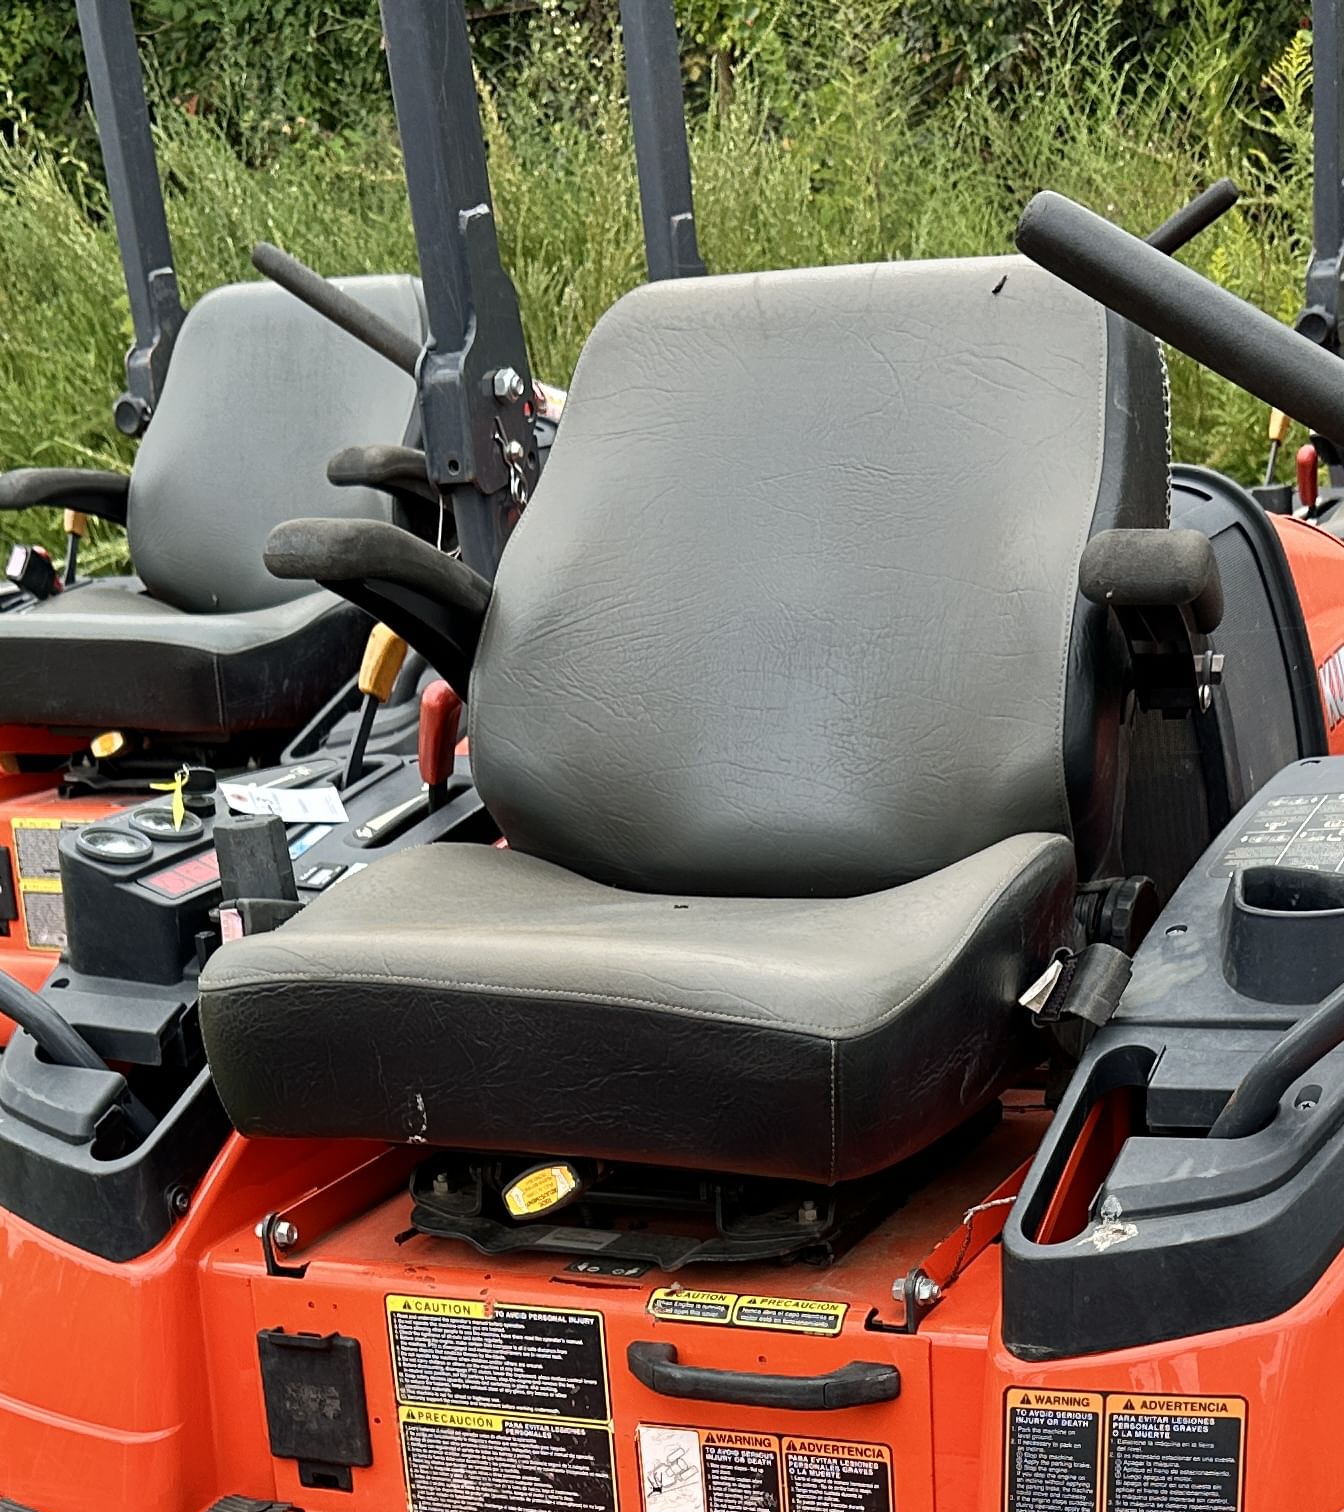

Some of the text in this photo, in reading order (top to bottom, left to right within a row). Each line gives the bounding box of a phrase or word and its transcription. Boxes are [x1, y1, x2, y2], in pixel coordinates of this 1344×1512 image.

[676, 1290, 728, 1301] CAUTION
[415, 1301, 471, 1315] CAUTION
[760, 1298, 839, 1311] PRECAUCIÓN
[506, 1311, 527, 1320] AVOID
[529, 1313, 567, 1323] PERSONAL
[569, 1317, 595, 1325] INJURY
[1034, 1394, 1090, 1407] WARNING
[1140, 1400, 1228, 1412] ADVERTENCIA
[418, 1411, 494, 1428] PRECAUCIÓN
[1016, 1408, 1092, 1420] TO AVOID SERIOUS
[1113, 1415, 1215, 1425] PARA EVITAR LESIONES
[1016, 1417, 1044, 1425] INJURY
[505, 1428, 552, 1439] PERSONALES
[1113, 1423, 1208, 1433] PERSONALES GRAVES
[716, 1433, 772, 1448] WARNING
[798, 1442, 885, 1460] ADVERTENCIA
[789, 1461, 840, 1473] PERSONALES
